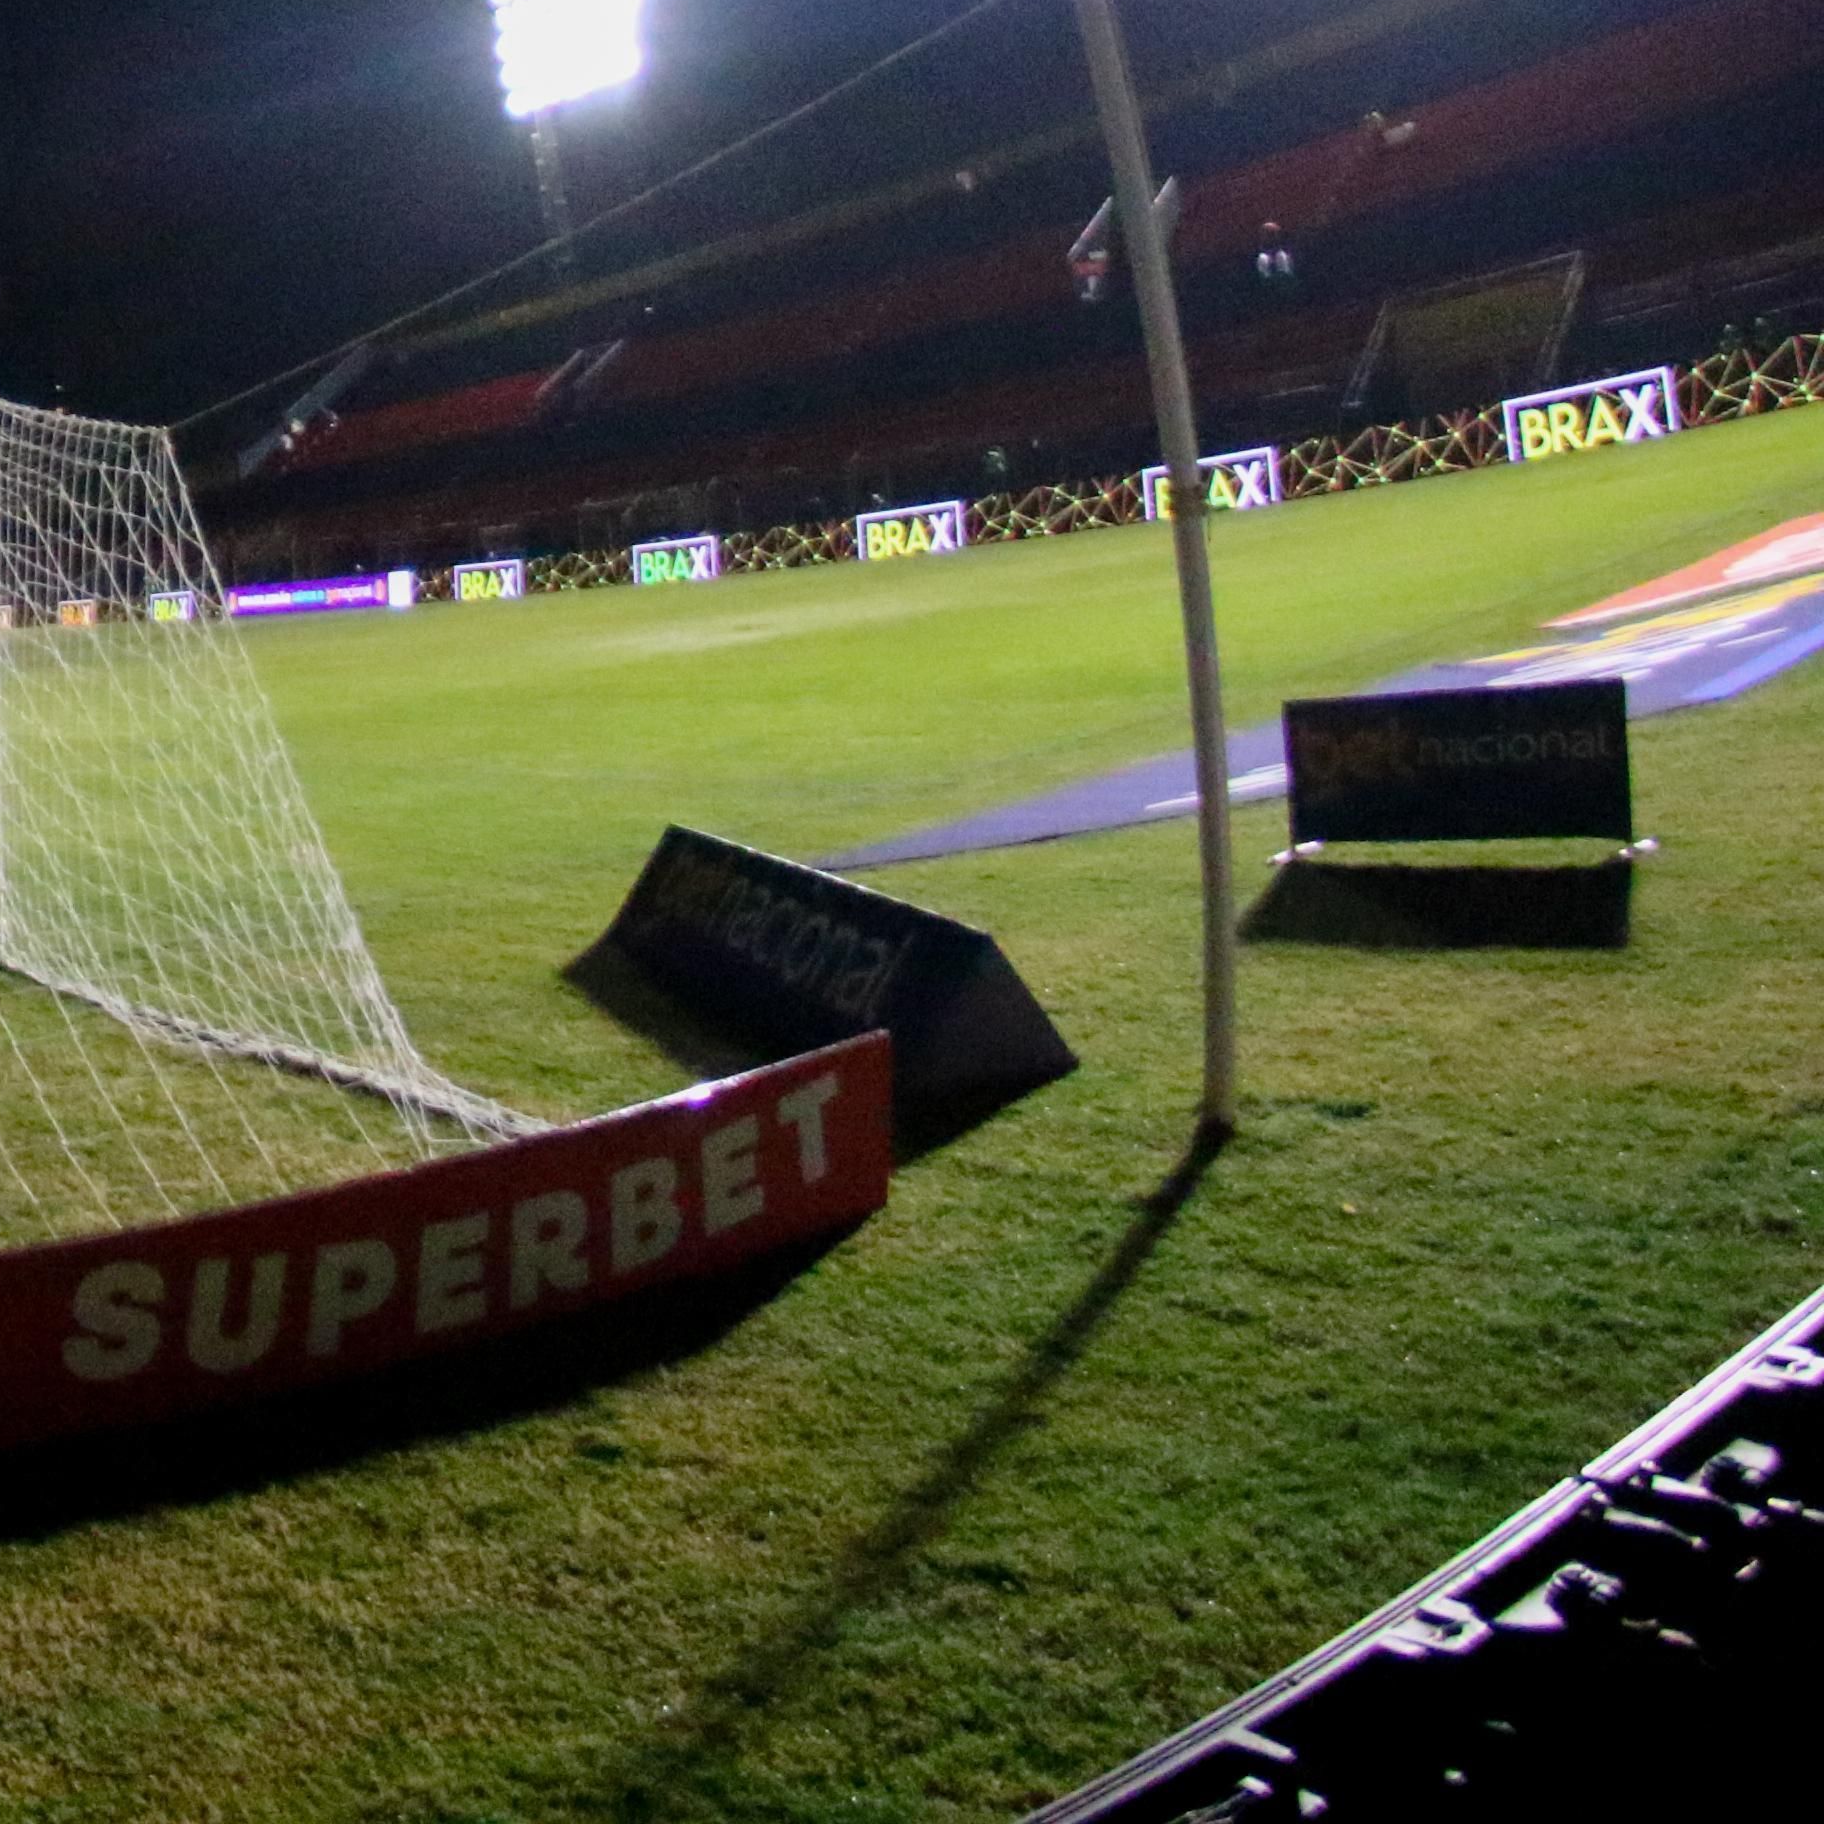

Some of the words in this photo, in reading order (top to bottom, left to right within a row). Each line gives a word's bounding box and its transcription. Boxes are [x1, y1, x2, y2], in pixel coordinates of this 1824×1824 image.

[1519, 383, 1660, 460] BRAX
[1155, 459, 1267, 520] BAX
[866, 511, 954, 560] BRAX
[459, 567, 517, 600] BRAX
[639, 545, 710, 585] BRAX
[1418, 720, 1617, 768] nacional
[61, 1073, 840, 1379] SUPERBET
